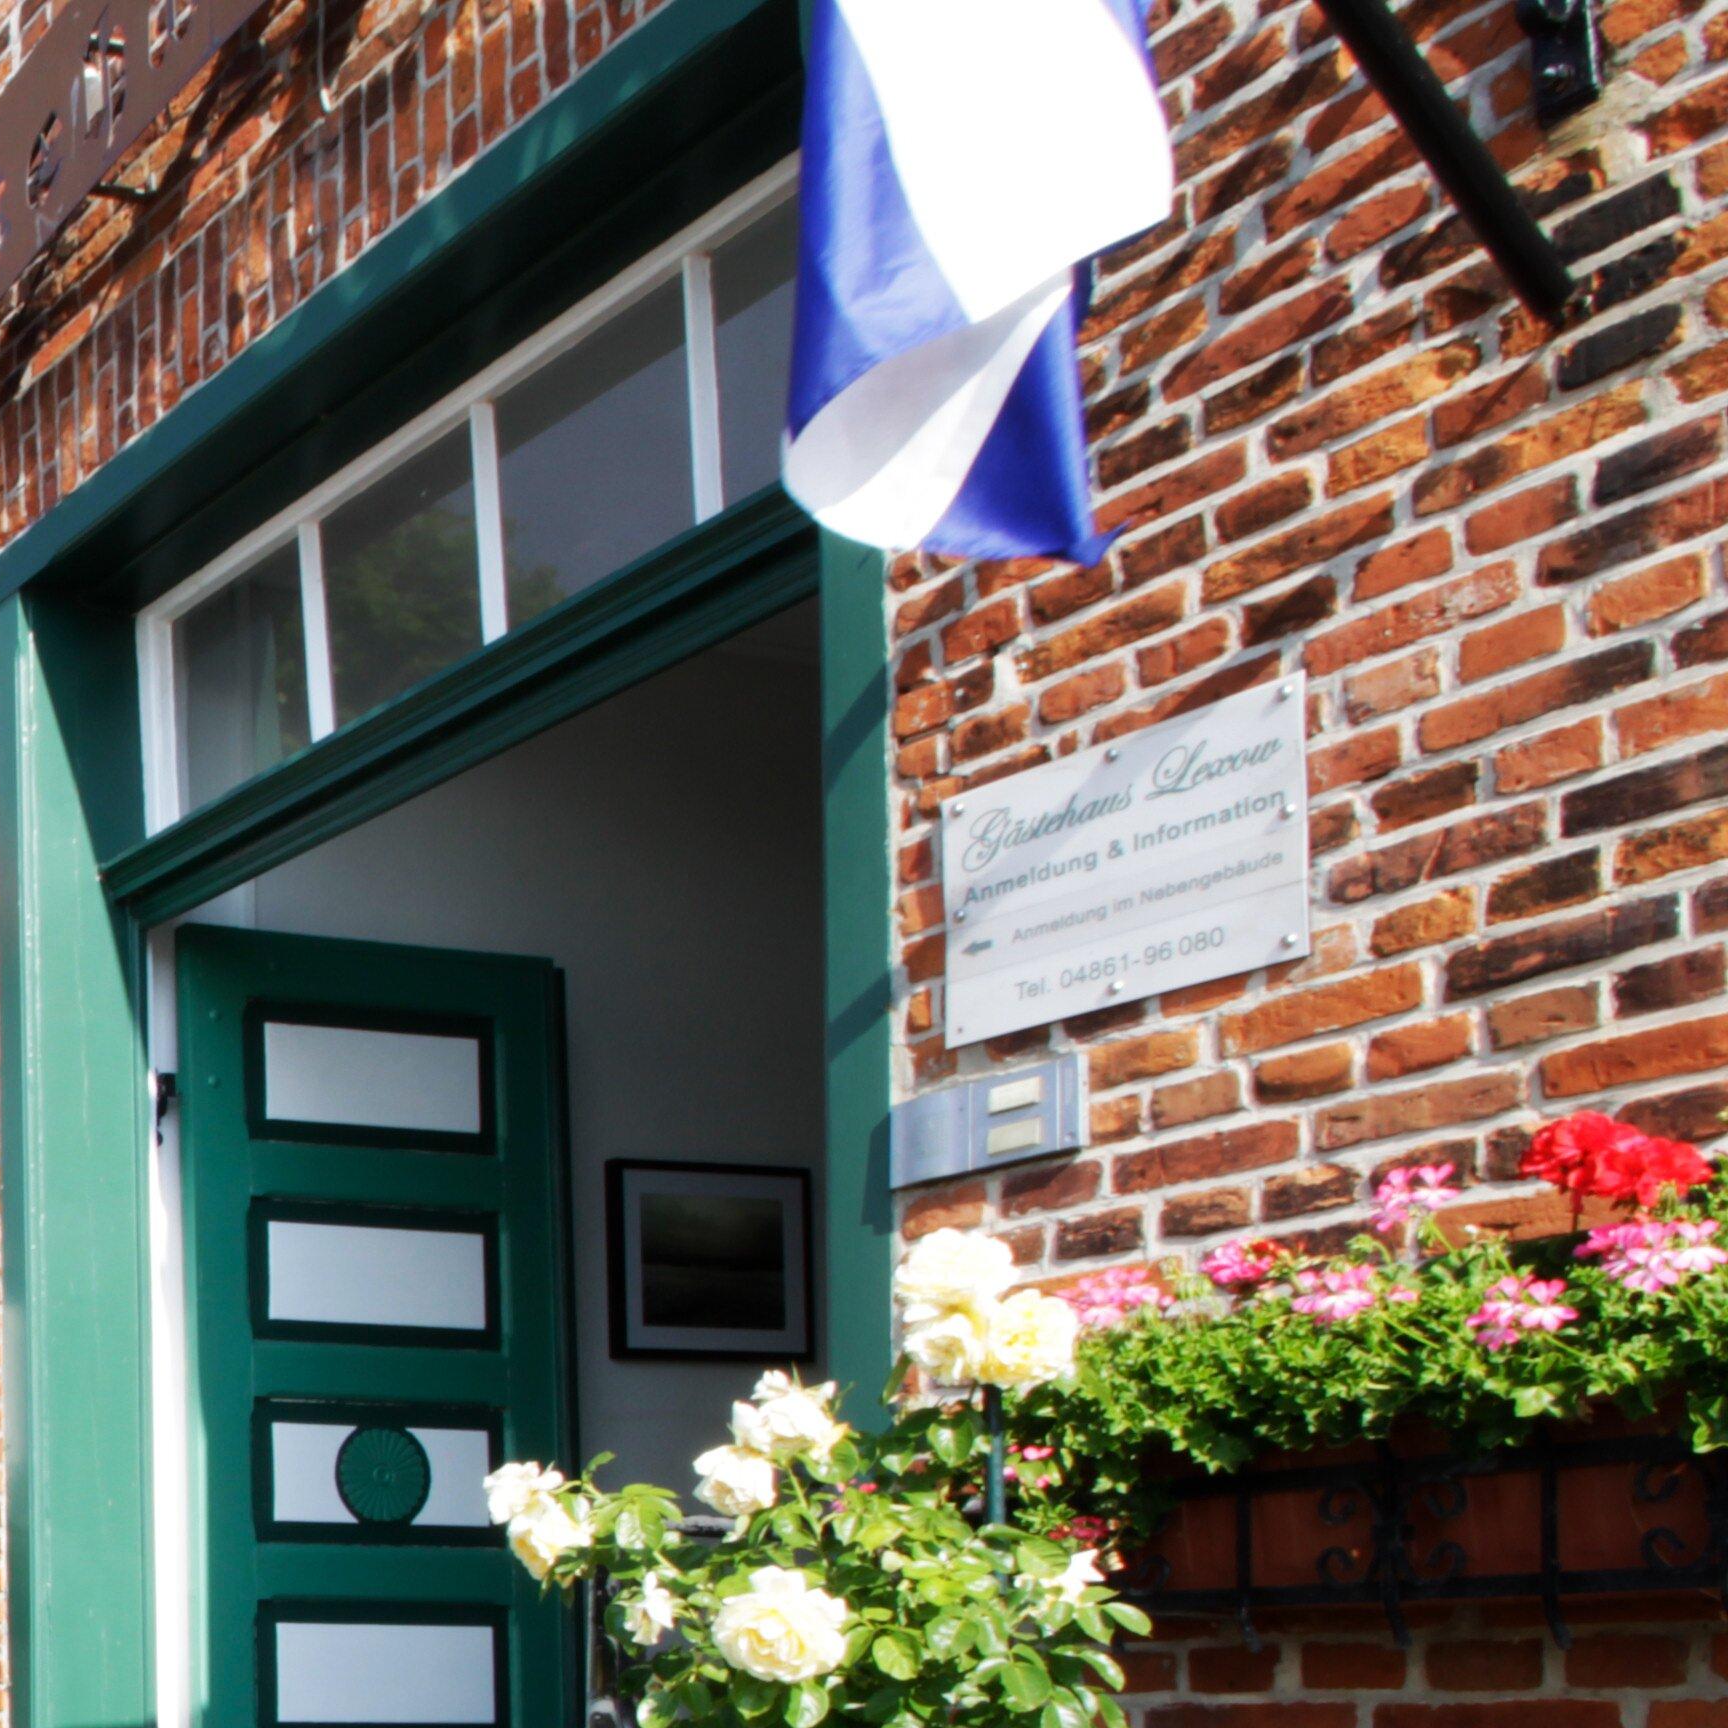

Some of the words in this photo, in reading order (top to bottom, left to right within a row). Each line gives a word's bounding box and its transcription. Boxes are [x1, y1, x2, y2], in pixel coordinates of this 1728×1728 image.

[962, 784, 1133, 873] Gästehaus
[1144, 738, 1283, 801] Lexow
[964, 851, 1098, 905] Anmeldung
[1107, 839, 1124, 859] &
[1133, 790, 1286, 851] Information
[1012, 905, 1108, 943] Anmeldung
[1113, 897, 1134, 913] im
[1140, 851, 1283, 905] Nebengebäude
[1015, 977, 1051, 1000] Tel.
[1178, 926, 1224, 956] 080
